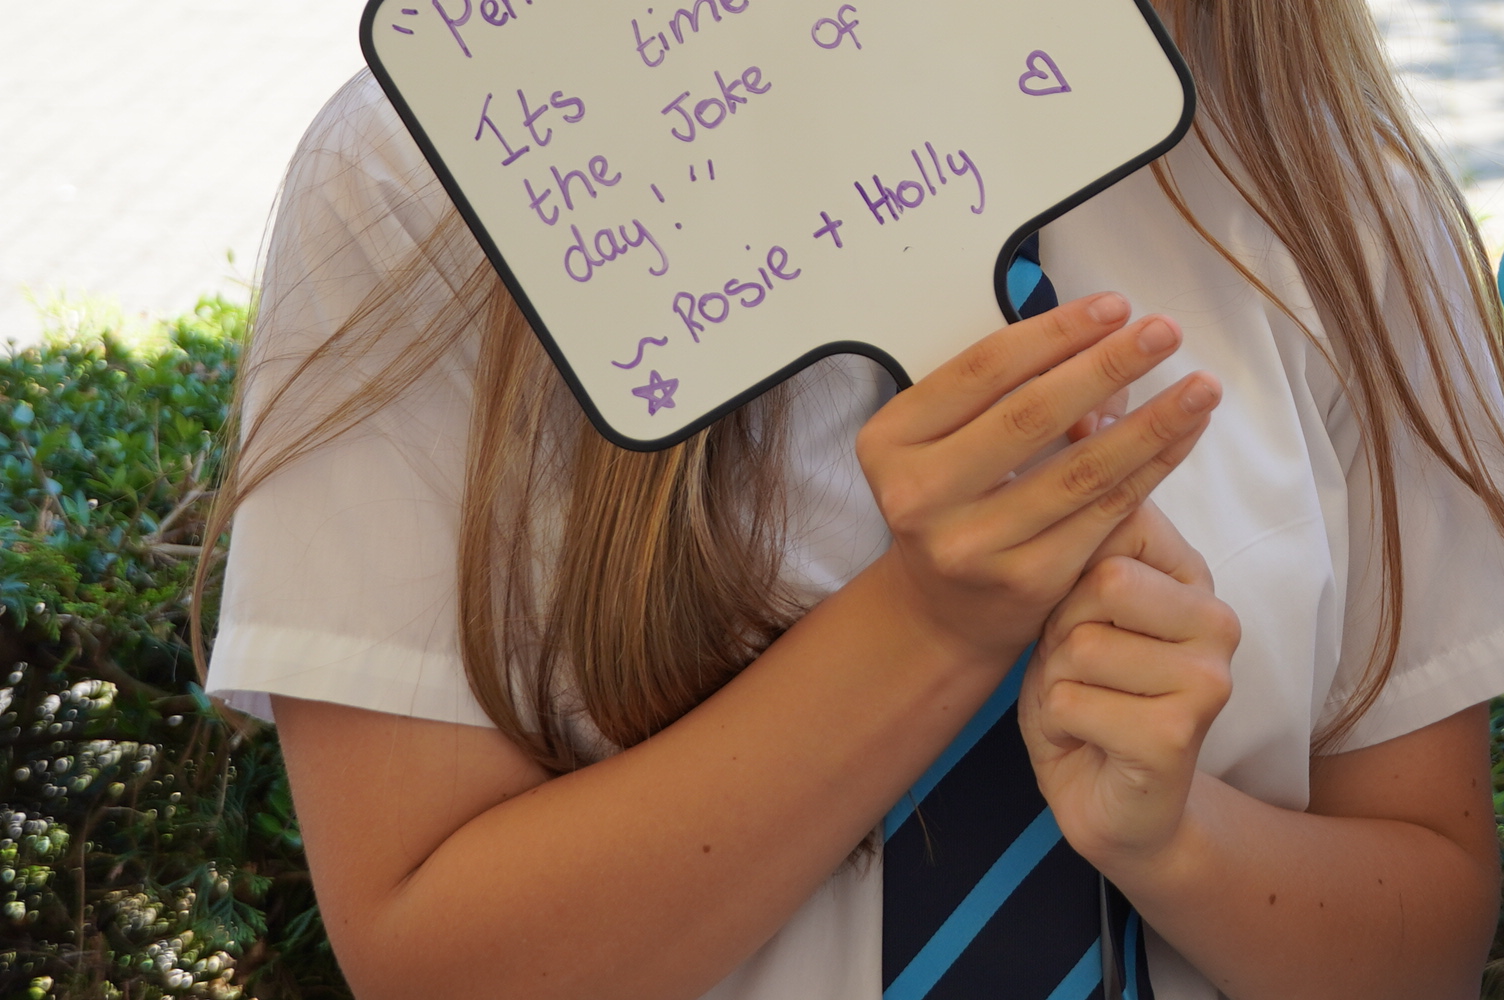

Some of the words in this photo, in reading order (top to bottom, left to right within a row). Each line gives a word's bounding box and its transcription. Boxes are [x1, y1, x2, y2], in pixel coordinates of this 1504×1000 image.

[474, 88, 586, 168] Its
[523, 155, 623, 227] the
[811, 3, 862, 51] of
[672, 242, 802, 344] Rosie
[853, 140, 986, 226] Holly
